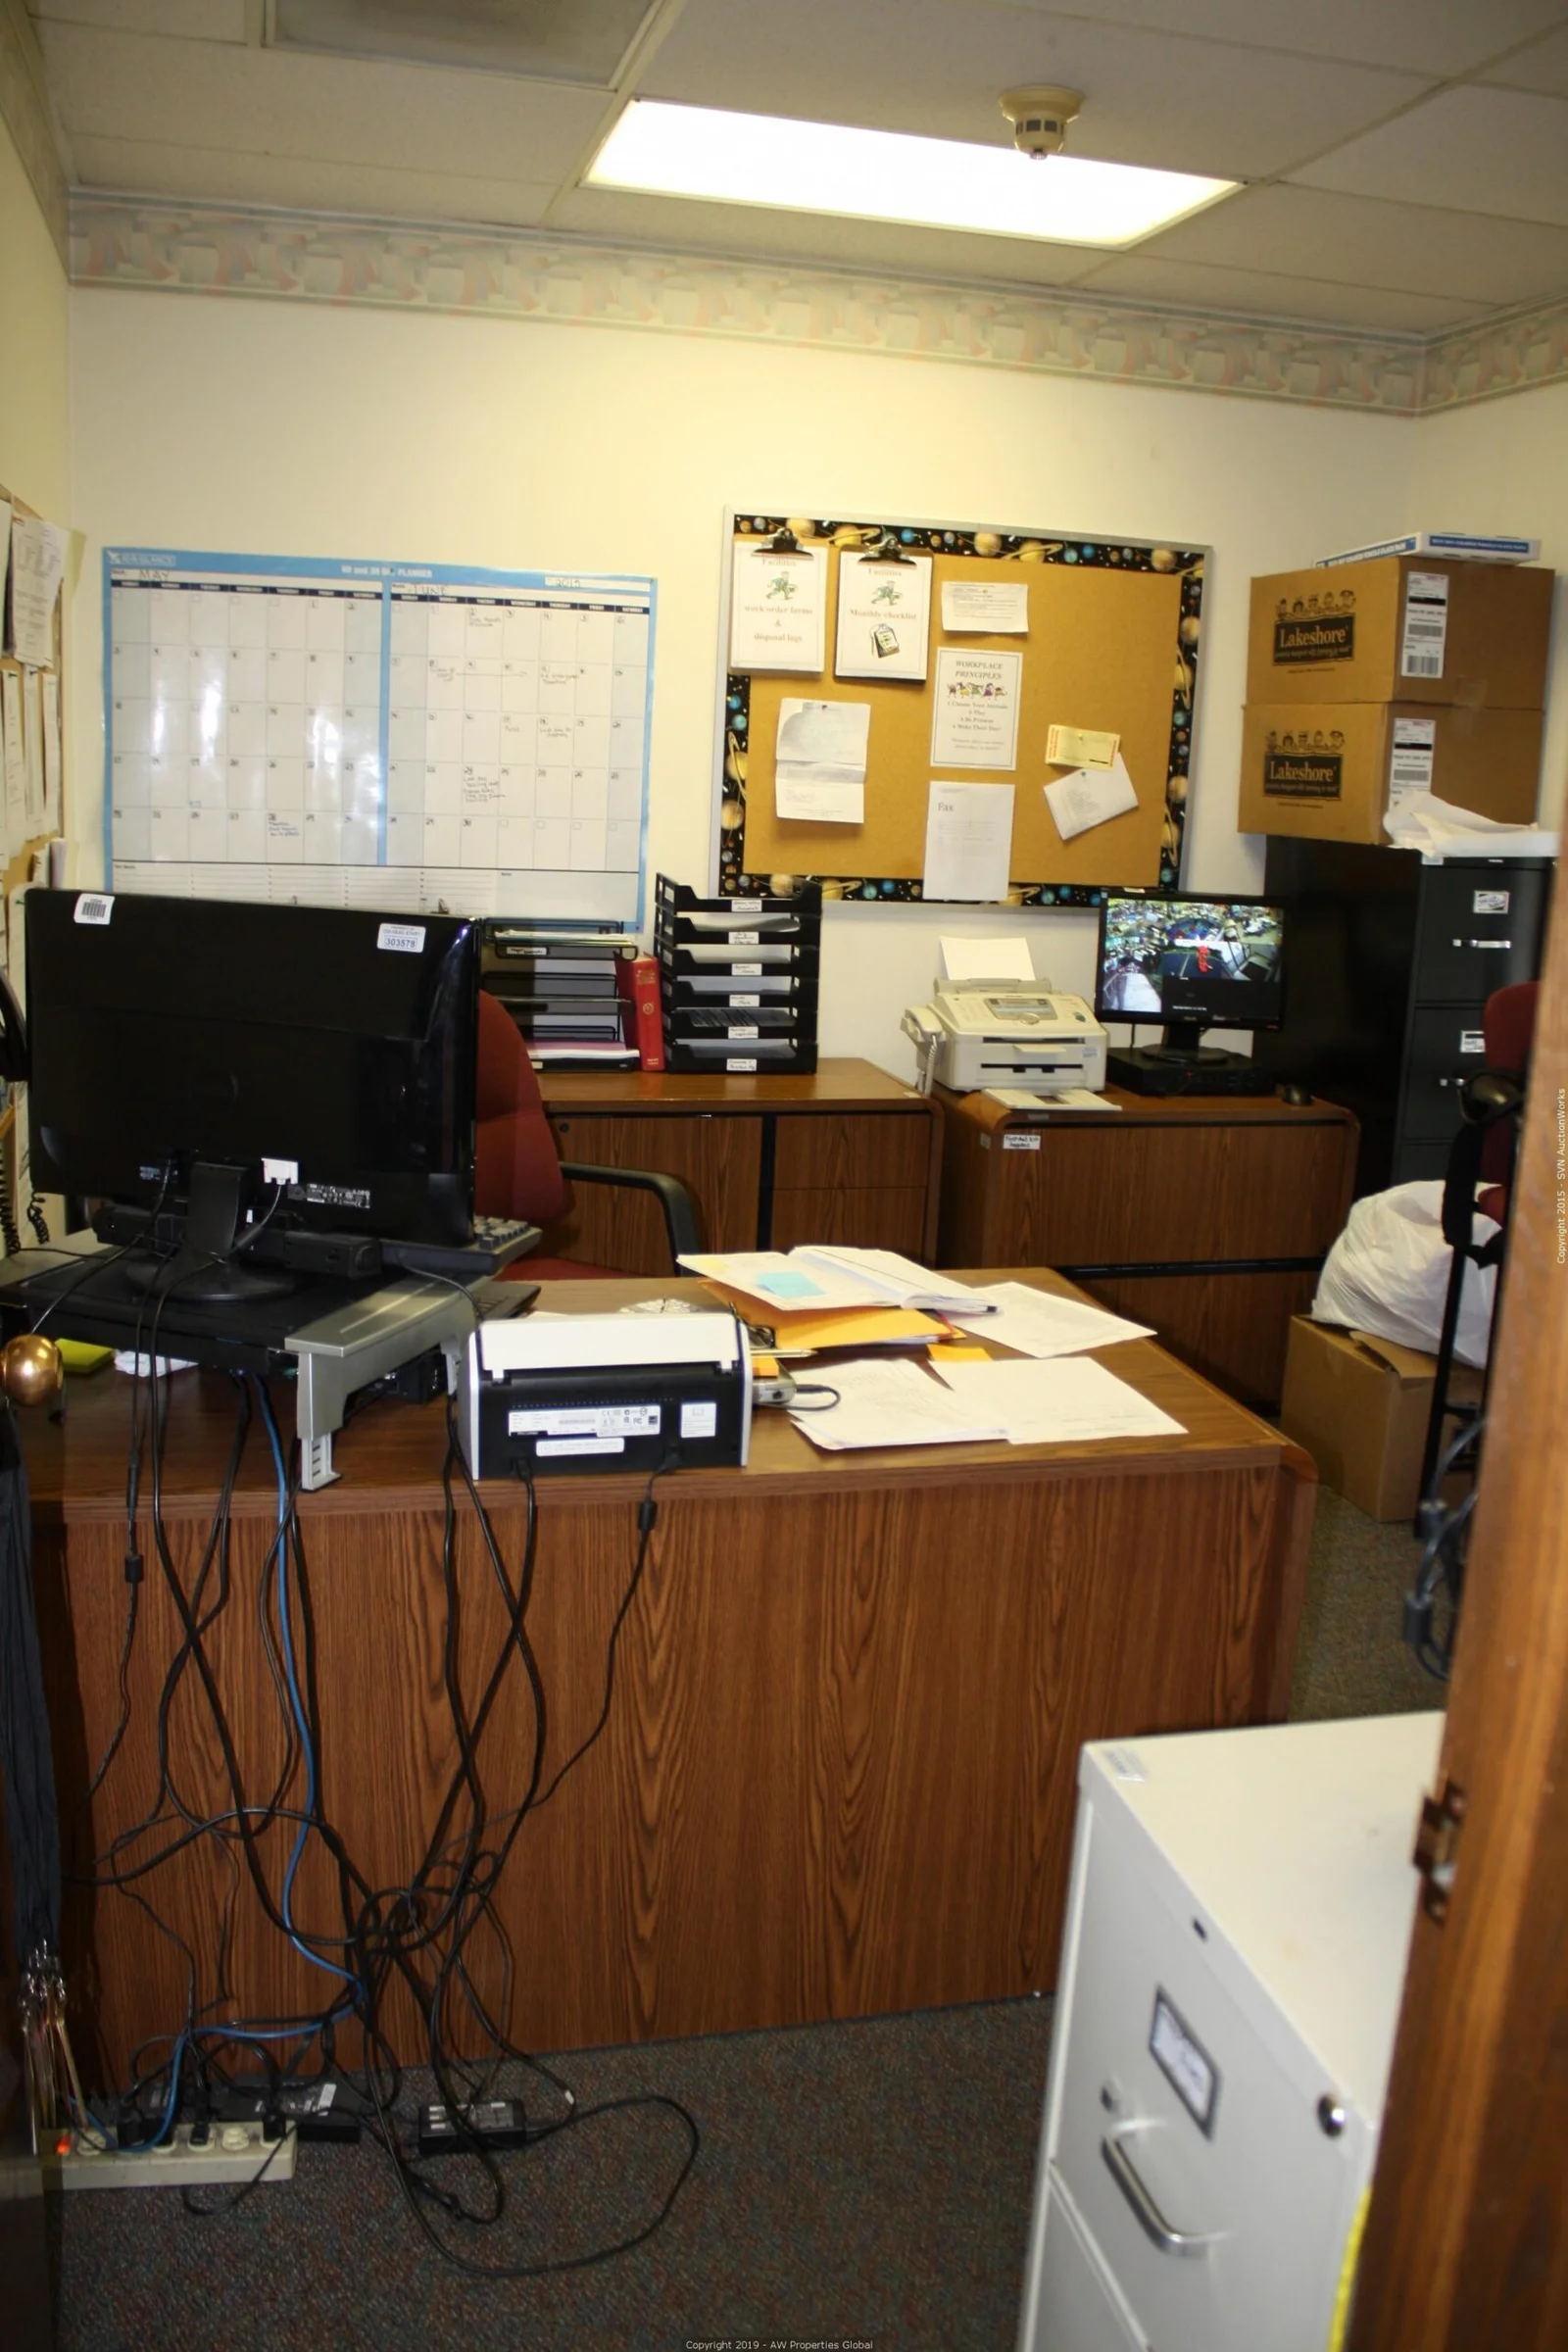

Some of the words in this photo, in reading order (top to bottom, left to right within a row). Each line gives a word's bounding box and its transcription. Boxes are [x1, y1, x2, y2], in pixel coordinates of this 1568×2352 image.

[139, 569, 170, 582] MAY
[745, 605, 765, 613] work
[766, 606, 787, 614] order
[790, 607, 812, 615] forms
[850, 609, 881, 619] Monthly
[884, 611, 917, 620] checklist
[1280, 625, 1347, 648] Lakeshore
[956, 661, 1004, 670] WORKPLACE
[955, 671, 1003, 680] PRINCIPLES
[1270, 760, 1334, 783] Lakeshore
[937, 802, 955, 812] Fax
